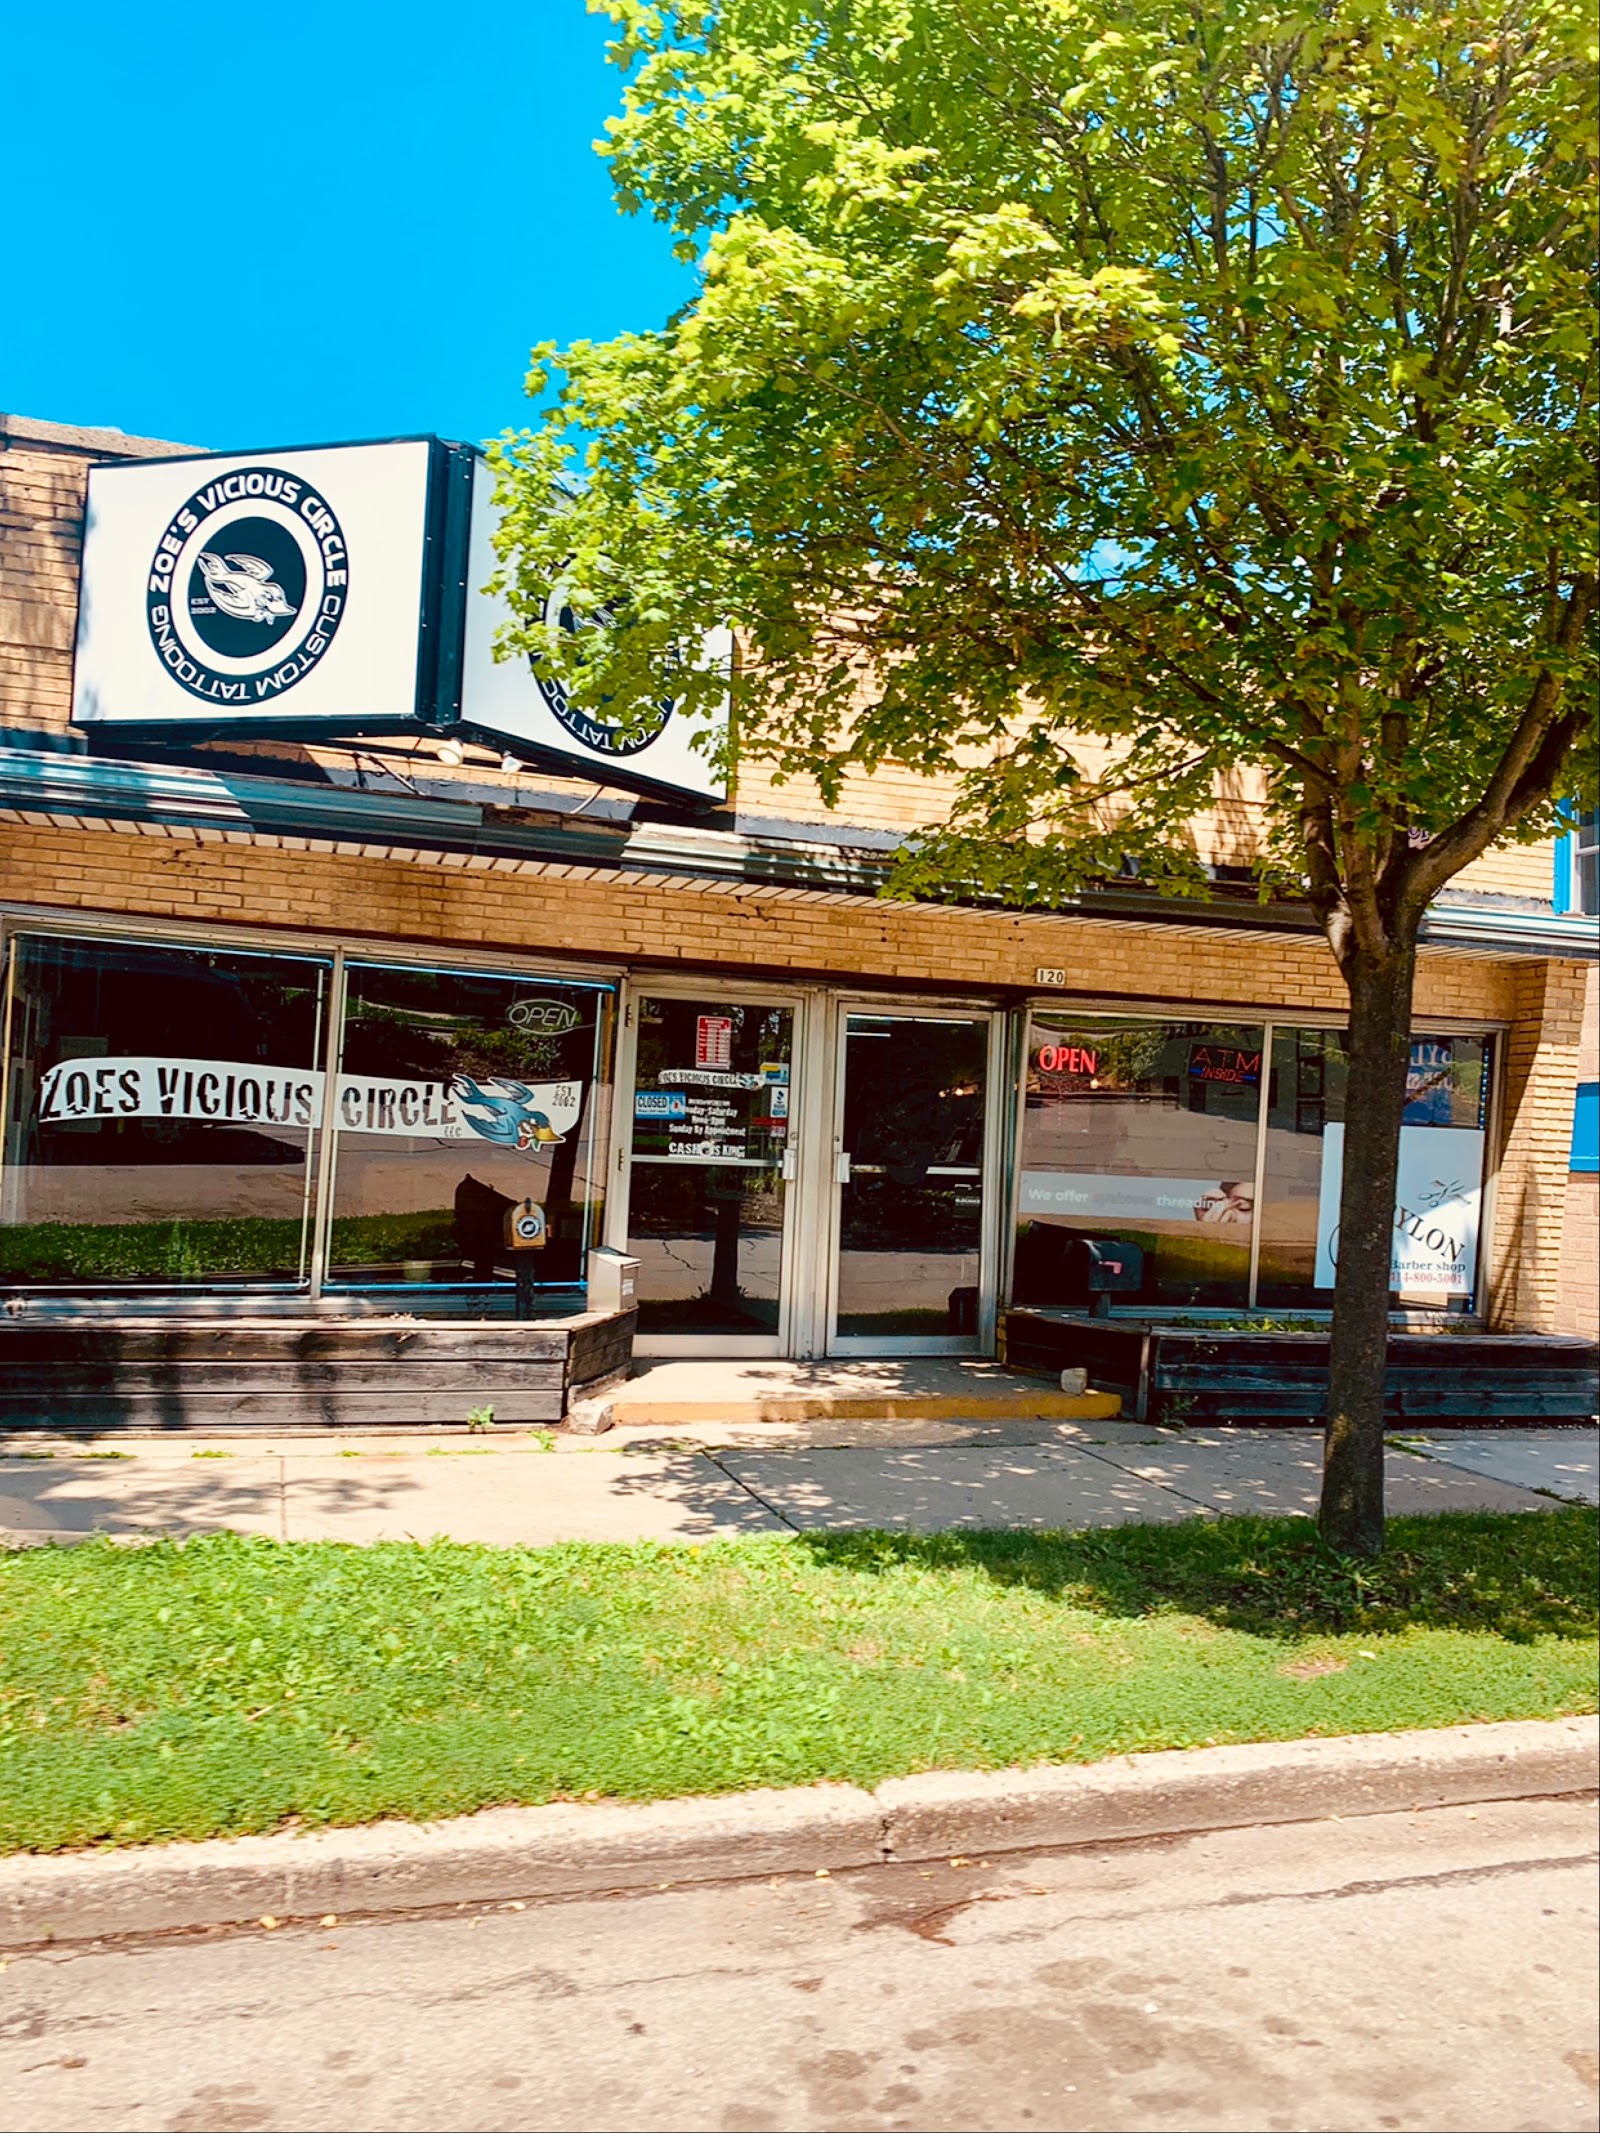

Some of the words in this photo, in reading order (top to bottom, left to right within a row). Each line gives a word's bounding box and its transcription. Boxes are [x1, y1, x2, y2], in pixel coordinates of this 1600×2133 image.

[149, 508, 198, 593] ZOE'S
[196, 473, 302, 512] VICIOUS
[300, 496, 347, 587] CIRCLE
[150, 605, 252, 700] TATTOOING
[255, 595, 341, 696] CUSTOM
[1040, 970, 1064, 983] 120
[508, 1005, 578, 1027] OPEN
[1039, 1045, 1097, 1075] OPEN
[1192, 1047, 1260, 1071] ATM
[1201, 1066, 1245, 1082] INSIDE
[39, 1068, 141, 1119] ZOES
[157, 1067, 314, 1125] VICIOUS
[341, 1083, 458, 1129] CIRCLE
[637, 1096, 668, 1108] CLOSED
[668, 1123, 693, 1134] Sunday
[668, 1141, 701, 1155] CASH
[1028, 1188, 1052, 1201] We
[1055, 1189, 1089, 1203] offer
[1156, 1194, 1226, 1213] threading
[1393, 1205, 1467, 1263] YLON
[1389, 1259, 1433, 1271] Barber
[1436, 1261, 1467, 1273] shop
[1388, 1272, 1463, 1284] 414-800-5001
